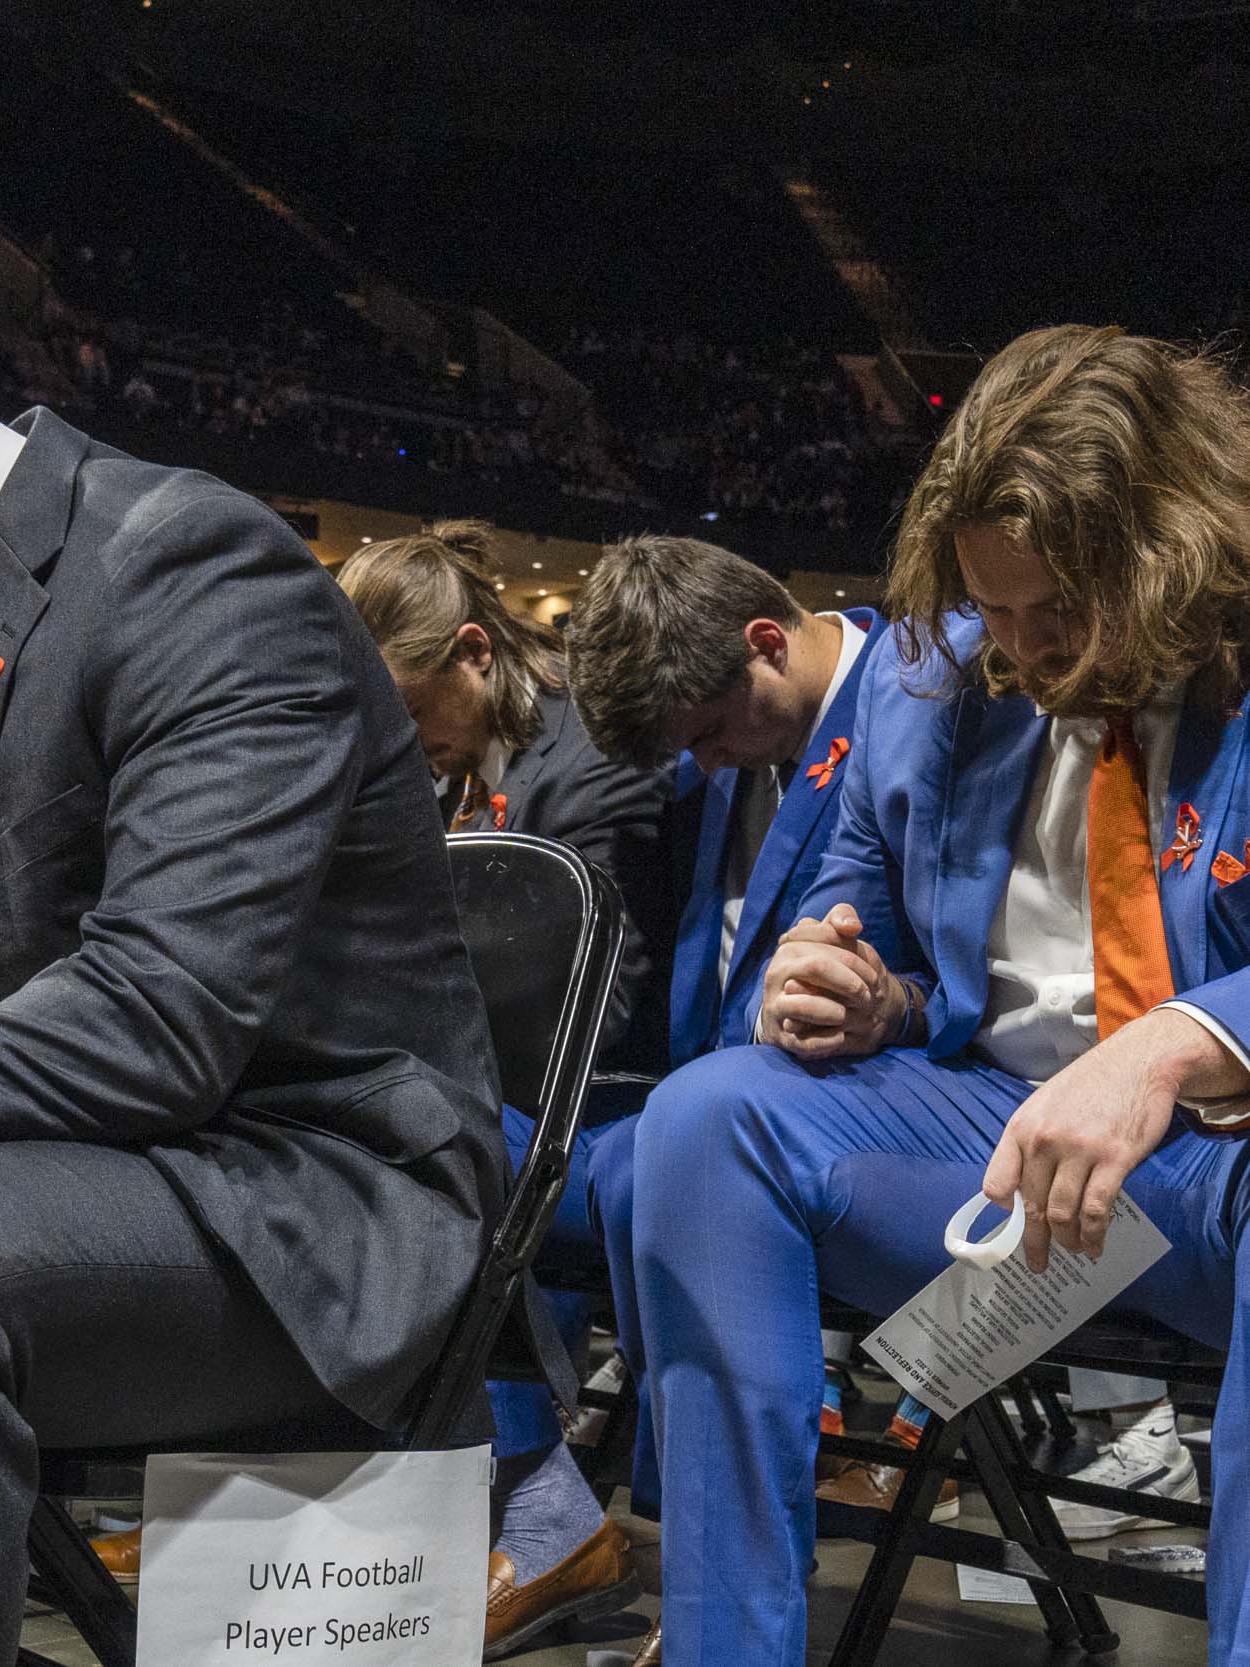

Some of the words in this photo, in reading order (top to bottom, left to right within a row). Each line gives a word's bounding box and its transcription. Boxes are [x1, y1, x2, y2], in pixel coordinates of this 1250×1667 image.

[873, 1335, 914, 1372] REFLECTION
[908, 1368, 926, 1384] AND
[249, 1562, 311, 1590] UVA
[322, 1555, 424, 1588] Football
[226, 1620, 316, 1654] Player
[324, 1613, 430, 1650] Speakers
